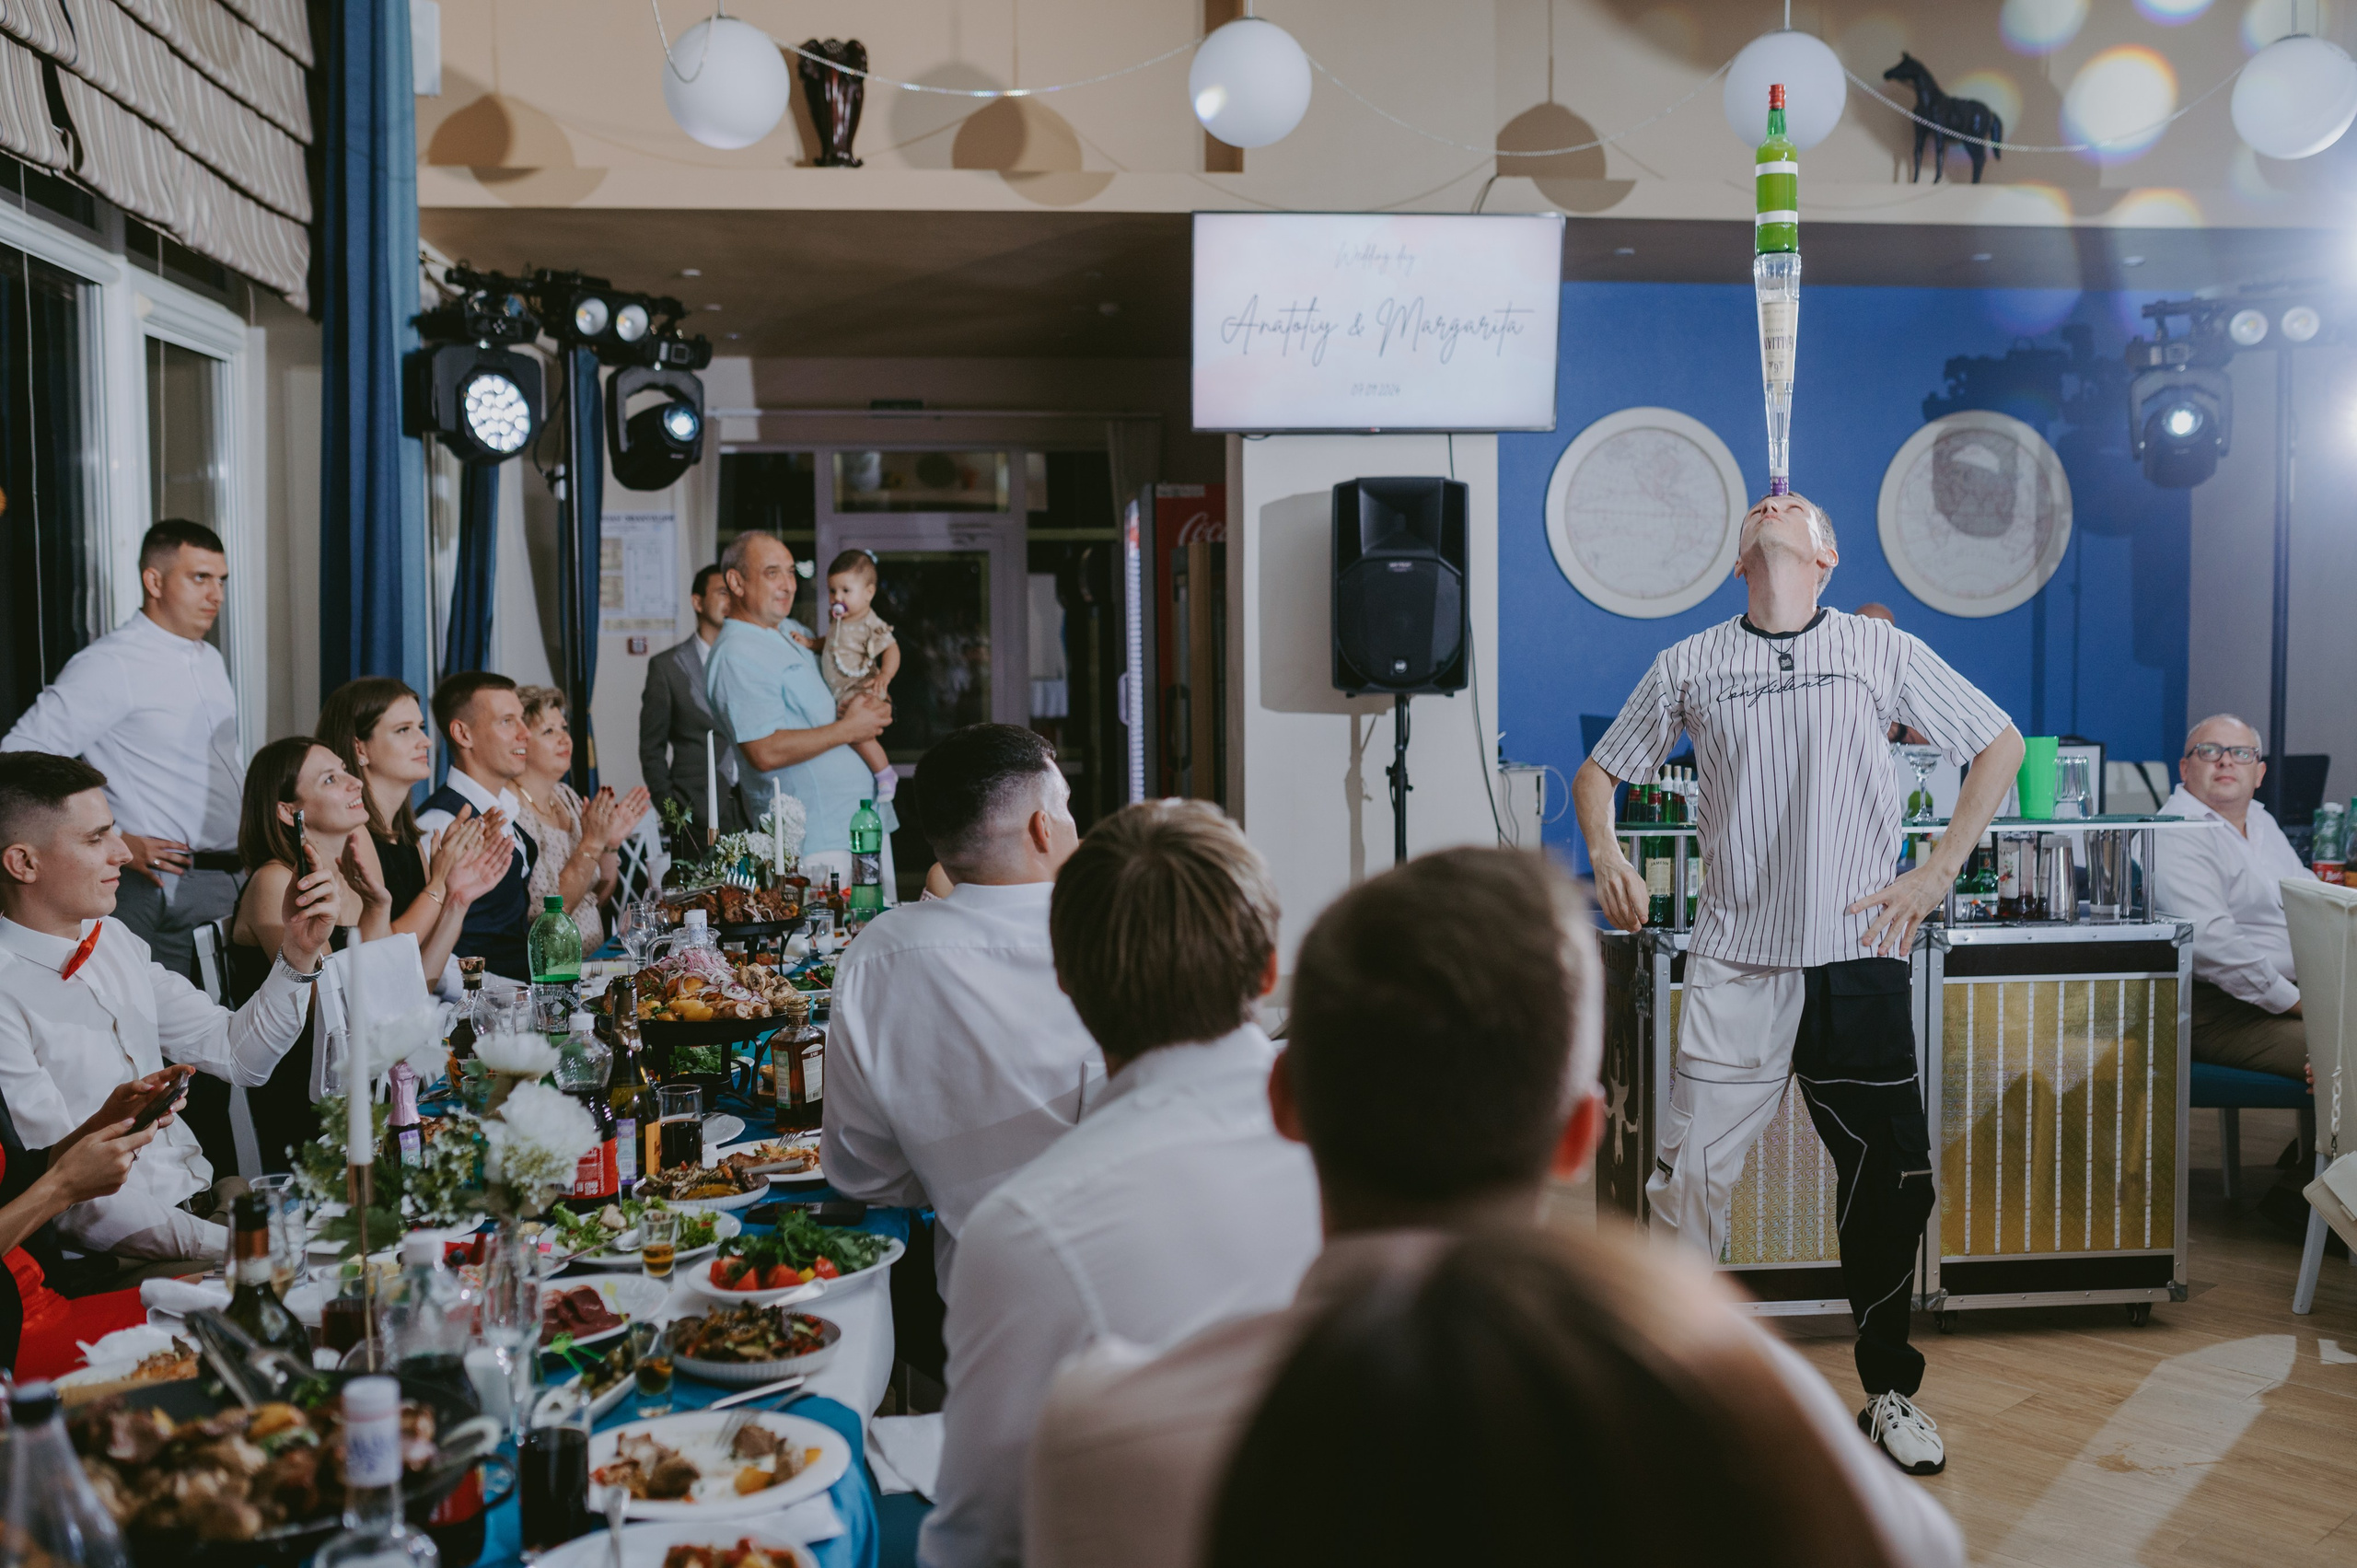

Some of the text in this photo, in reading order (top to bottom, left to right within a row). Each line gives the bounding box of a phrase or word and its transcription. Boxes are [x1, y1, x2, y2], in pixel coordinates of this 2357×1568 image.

[1348, 311, 1364, 337] &
[1376, 296, 1535, 366] Margarita
[1716, 674, 1836, 708] Confident
